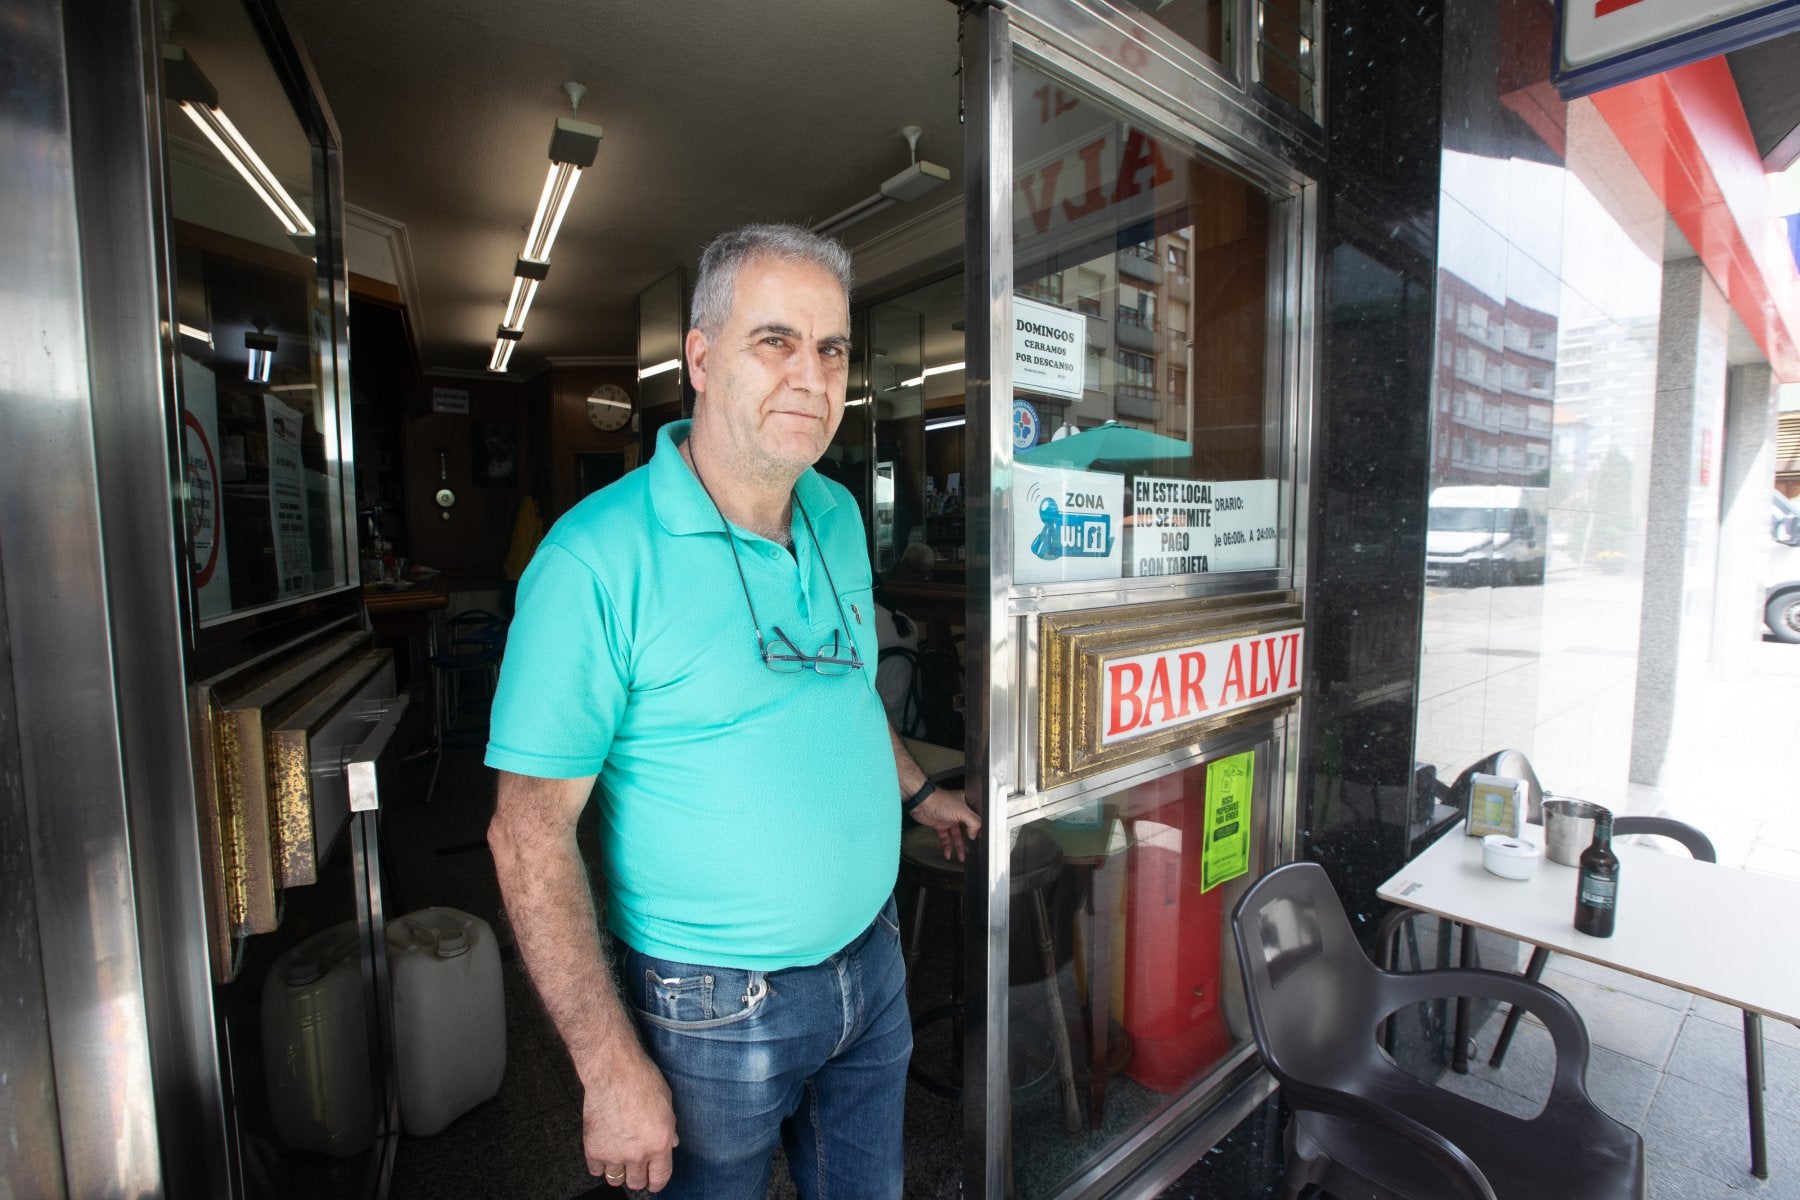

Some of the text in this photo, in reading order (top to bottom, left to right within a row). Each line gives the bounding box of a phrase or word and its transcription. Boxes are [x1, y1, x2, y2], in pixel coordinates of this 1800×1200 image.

[1016, 319, 1075, 343] DOMINGOS
[1024, 339, 1067, 356] CERRAMOS
[1016, 352, 1033, 364] POR
[1033, 356, 1074, 372] DESCANSO
[1065, 492, 1104, 509] ZONA
[1136, 481, 1212, 504] EN ESTE LOCAL
[1214, 497, 1244, 511] ORARIO:
[1137, 507, 1211, 528] NO SE ADMITE
[1161, 532, 1190, 552] PAGO
[1223, 530, 1247, 545] 06:00h.
[1249, 529, 1254, 542] A
[1140, 555, 1209, 576] CON TARJETA
[1107, 633, 1300, 736] BAR ALVI
